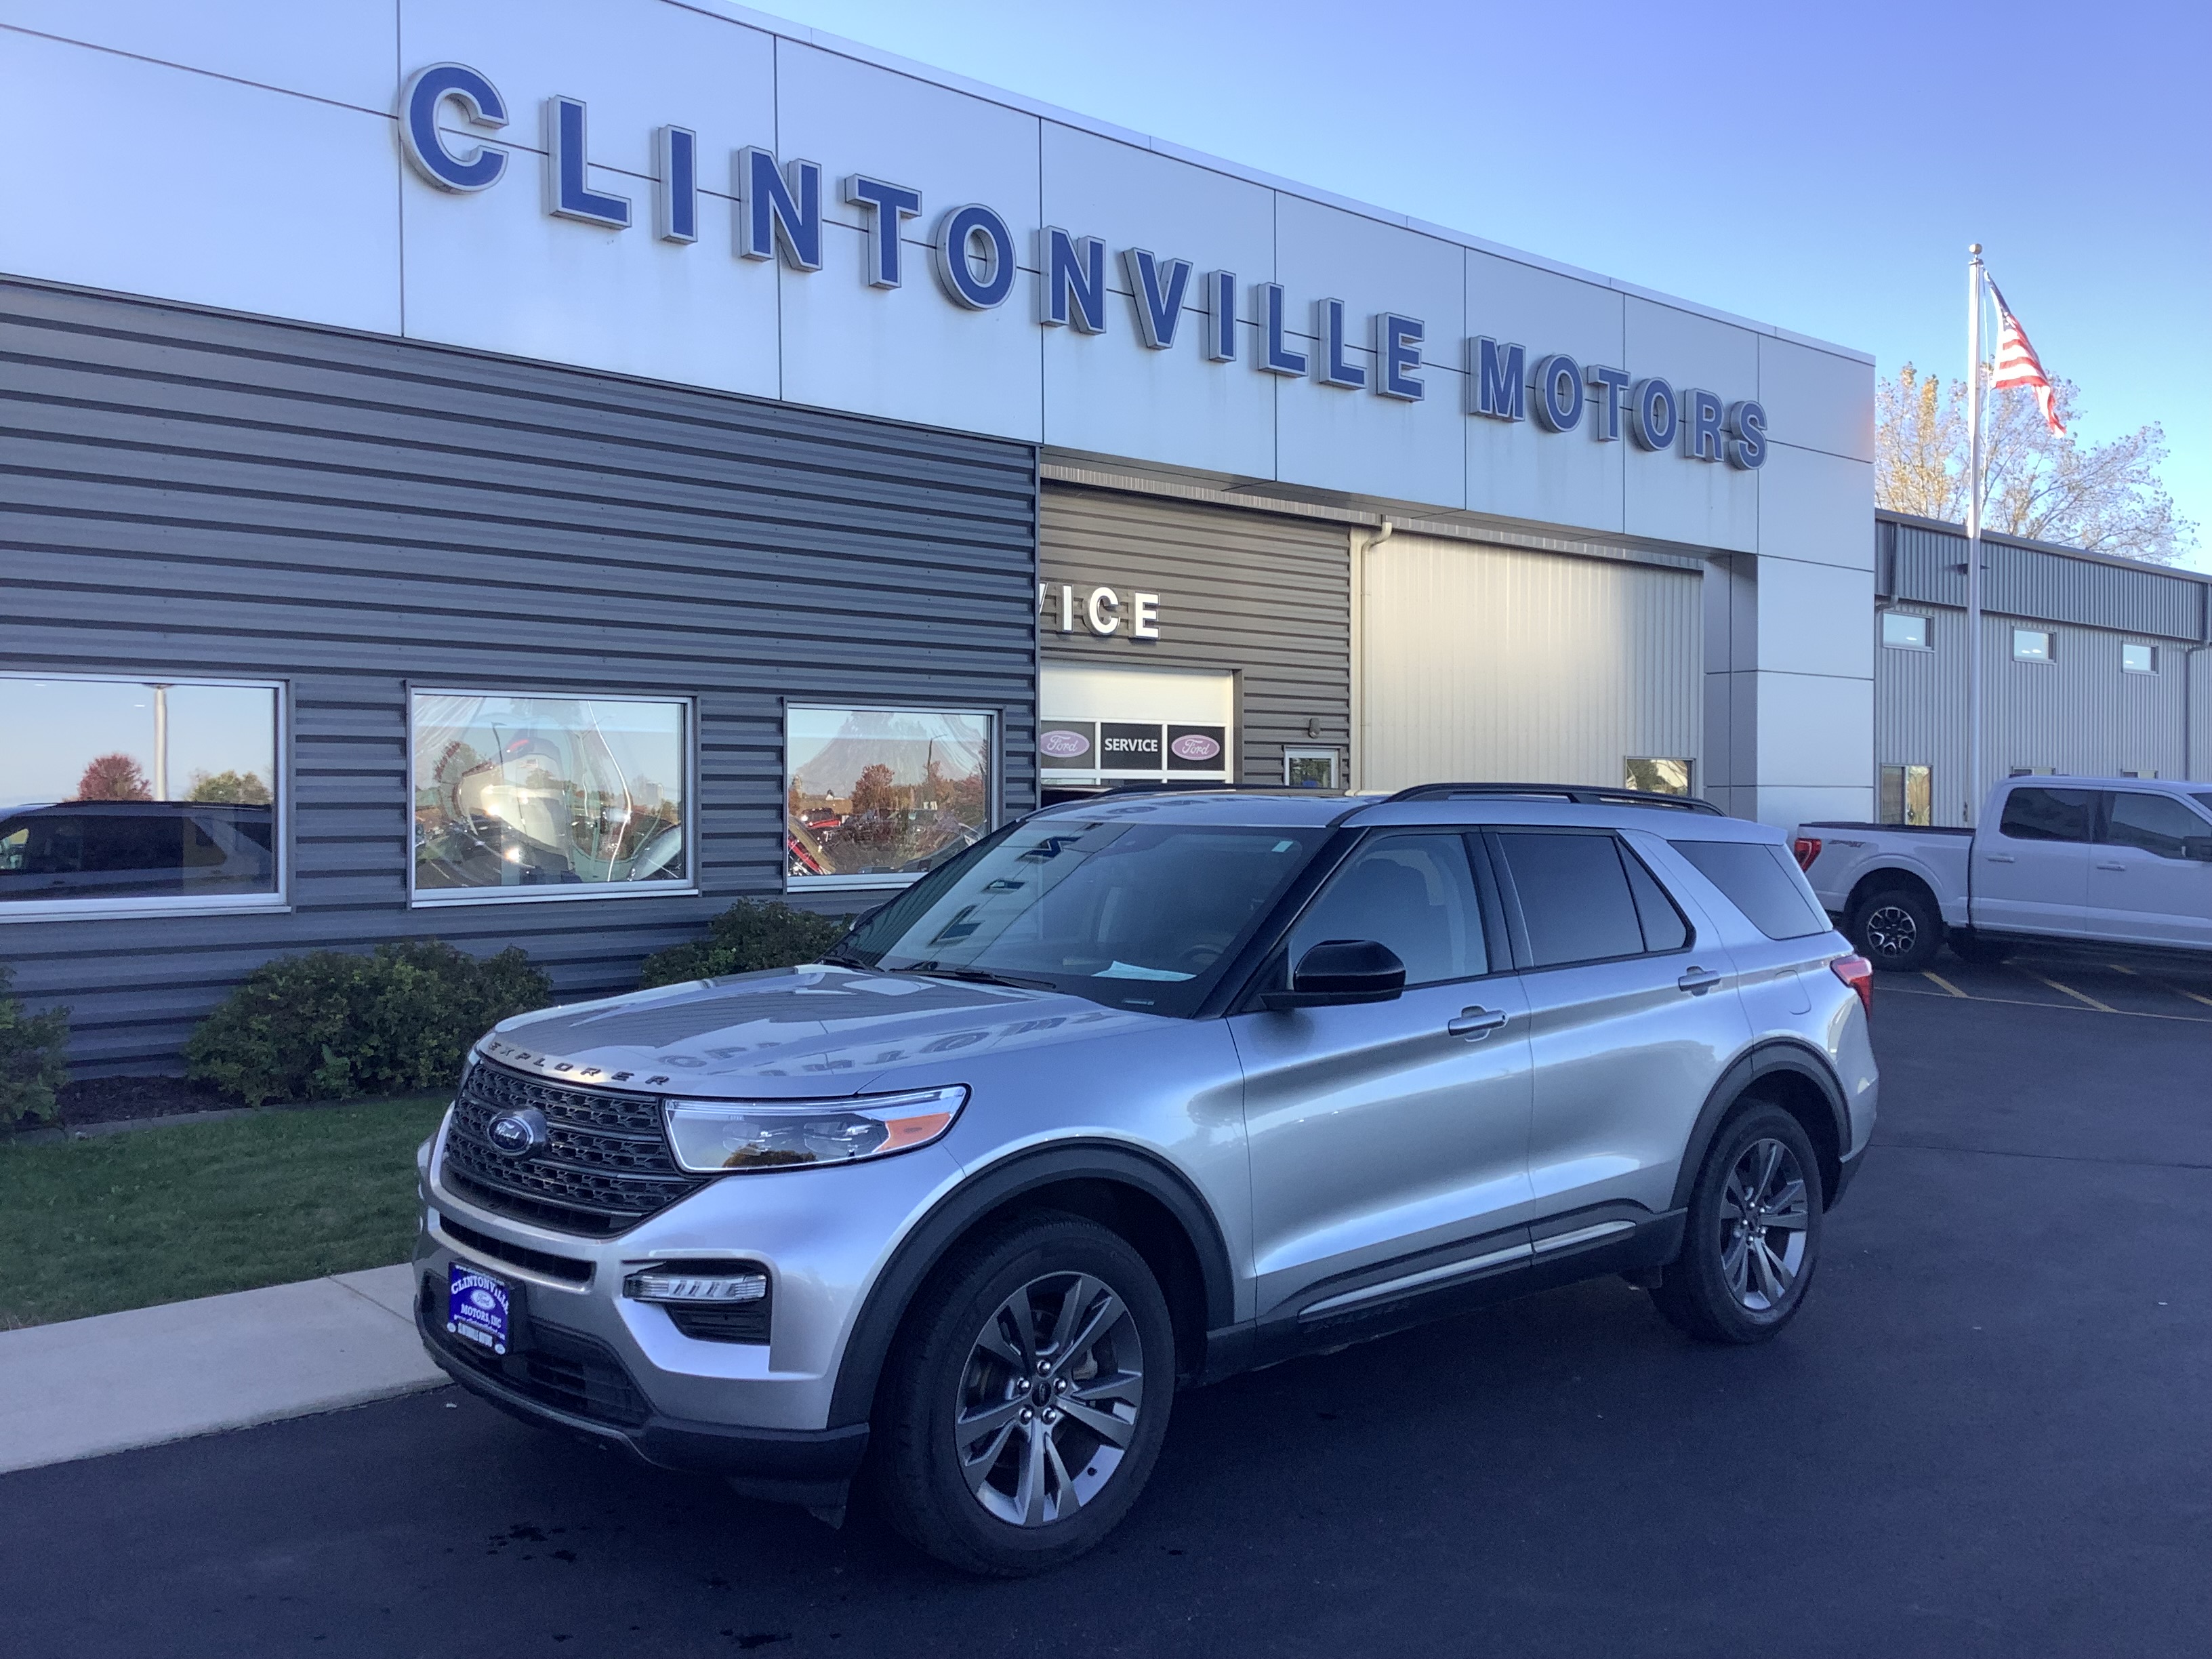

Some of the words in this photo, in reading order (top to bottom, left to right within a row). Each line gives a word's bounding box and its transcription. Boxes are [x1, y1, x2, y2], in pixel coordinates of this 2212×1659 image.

[398, 62, 1425, 403] CLINTONVILLE
[1469, 334, 1767, 470] MOTORS
[1040, 583, 1160, 640] ICE
[1105, 738, 1158, 752] SERVICE
[488, 1042, 670, 1086] EXPLORER
